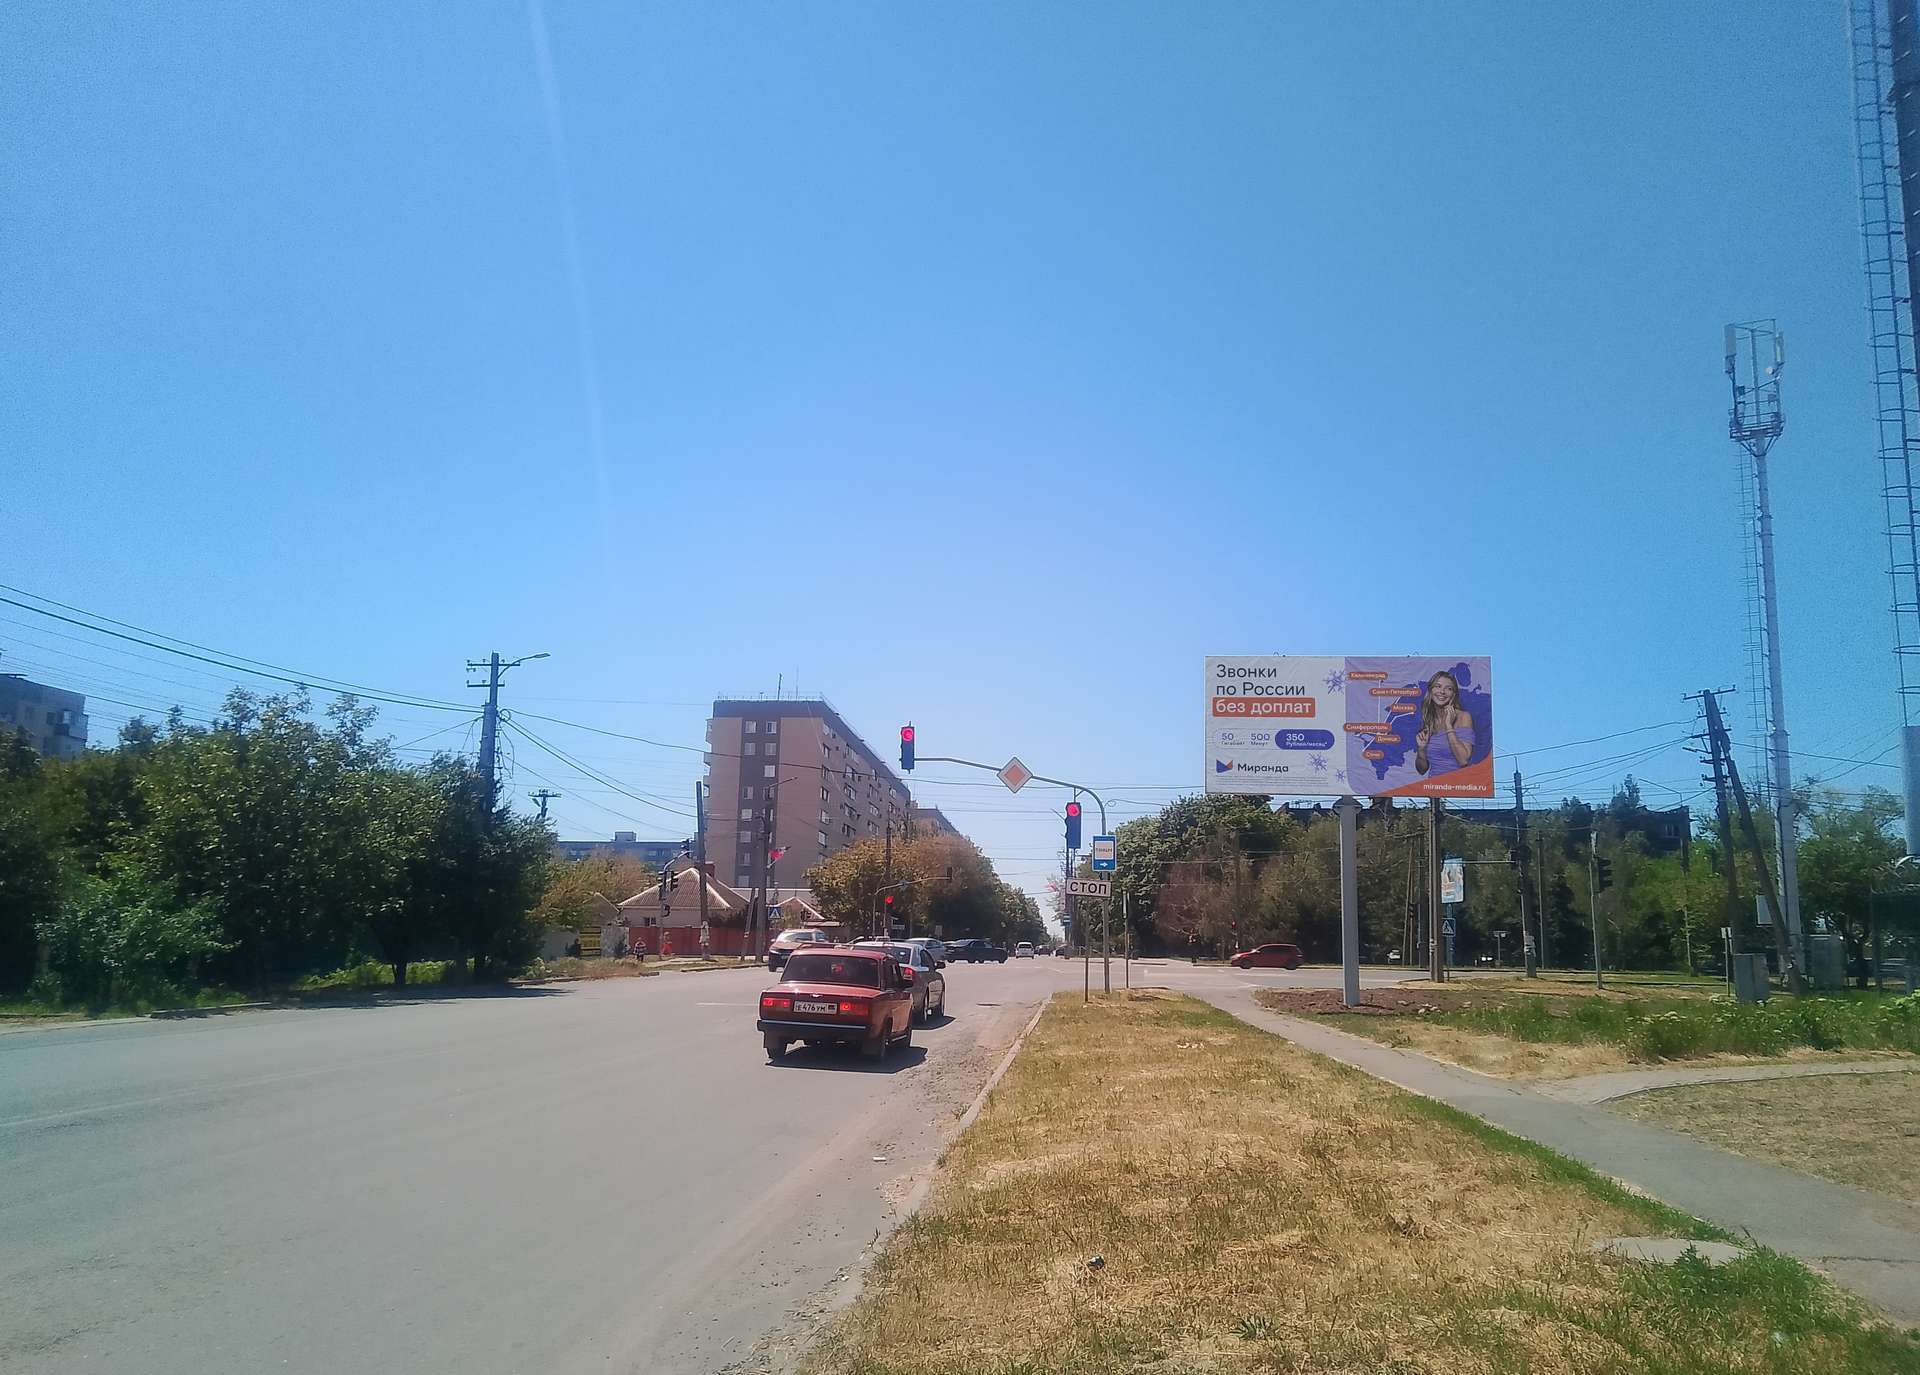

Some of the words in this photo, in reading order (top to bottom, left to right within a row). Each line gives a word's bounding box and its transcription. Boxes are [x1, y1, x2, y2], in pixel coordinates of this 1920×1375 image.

[1216, 664, 1277, 678] Звонки
[1216, 686, 1237, 696] по
[1242, 682, 1305, 696] России
[1215, 699, 1246, 713] без
[1250, 703, 1312, 715] доплат
[1221, 733, 1235, 741] 50
[1250, 733, 1271, 741] 500
[1285, 733, 1306, 741] 350
[1237, 763, 1289, 774] Миранда
[1423, 783, 1488, 792] miranda-media.ru
[1069, 882, 1107, 895] СТОП
